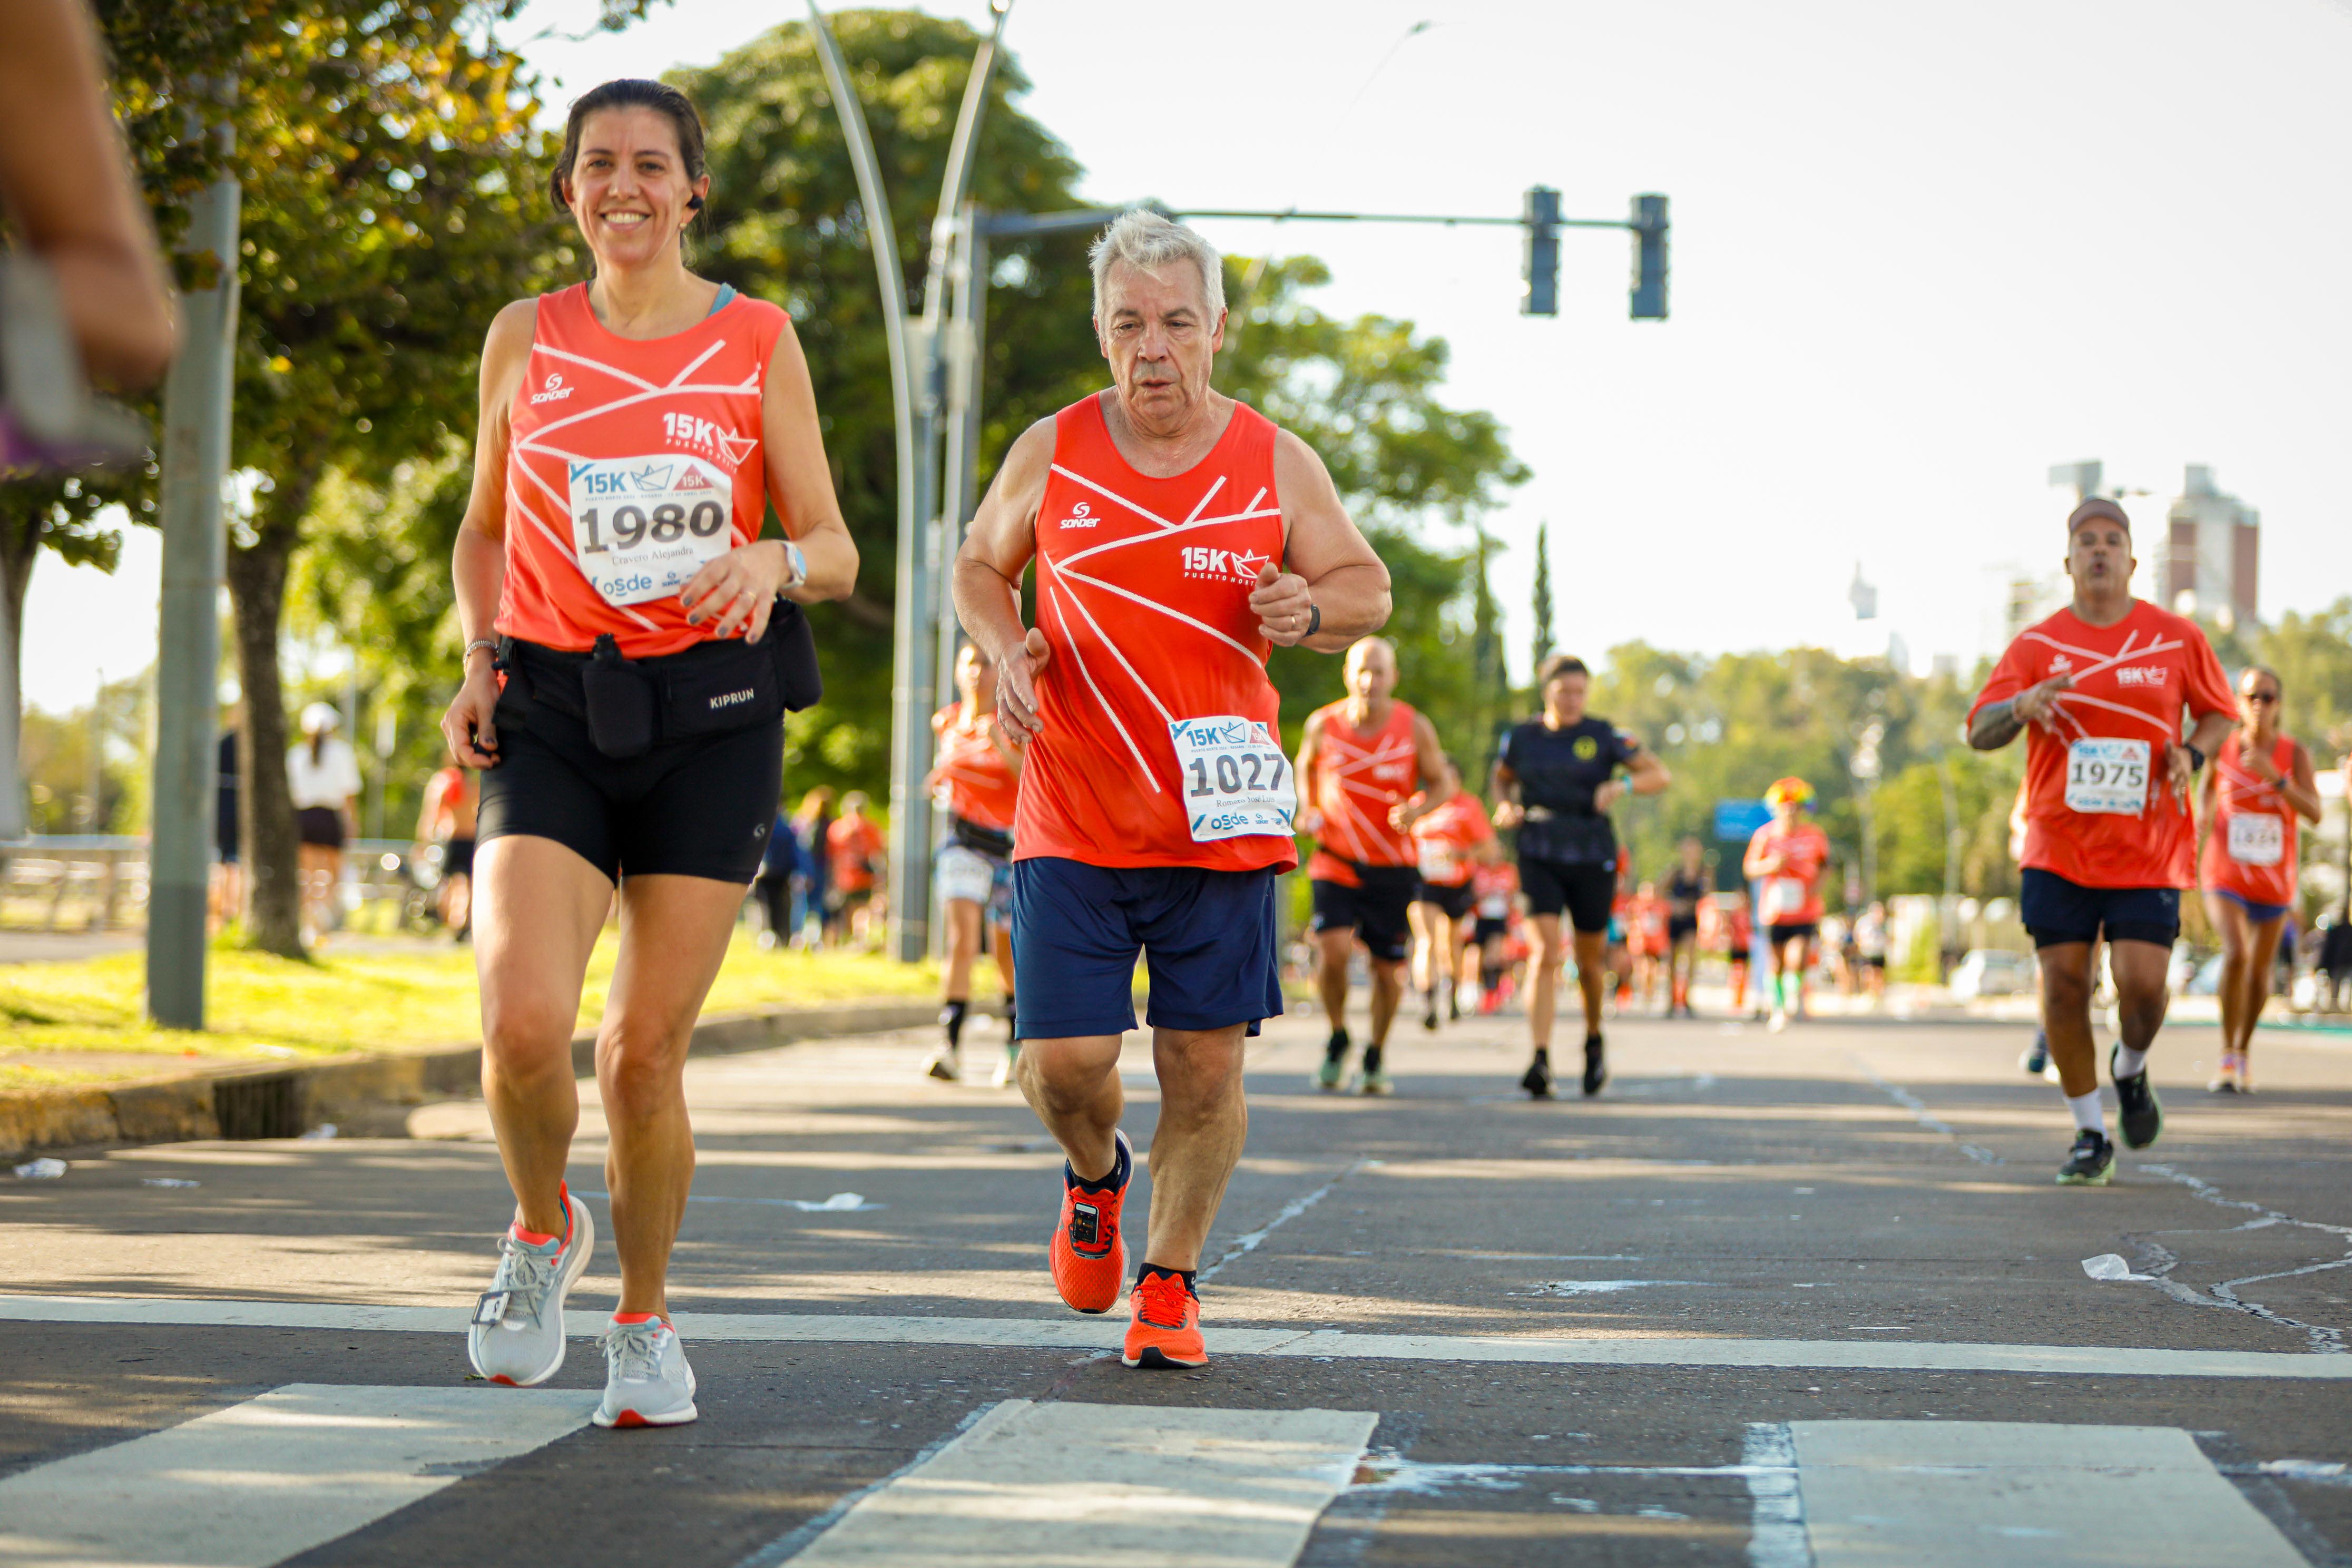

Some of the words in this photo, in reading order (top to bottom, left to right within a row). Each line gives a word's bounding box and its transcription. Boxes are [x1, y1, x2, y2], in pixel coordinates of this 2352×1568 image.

[663, 412, 715, 447] 15K
[666, 438, 713, 456] PUERTO
[584, 472, 627, 494] 15K
[682, 475, 705, 487] 15K
[580, 500, 724, 554] 1980
[612, 555, 649, 565] Cravero
[652, 546, 694, 560] Alejandra
[1182, 547, 1229, 573] 15K
[603, 573, 652, 596] osde
[1184, 572, 1227, 581] PUERTO
[1231, 576, 1256, 586] NORT
[710, 688, 754, 709] KIPRUN
[1187, 727, 1221, 747] 15K
[1188, 753, 1285, 797] 1027
[2071, 761, 2143, 788] 1975
[1216, 799, 1246, 808] Romero
[1211, 813, 1249, 830] osde
